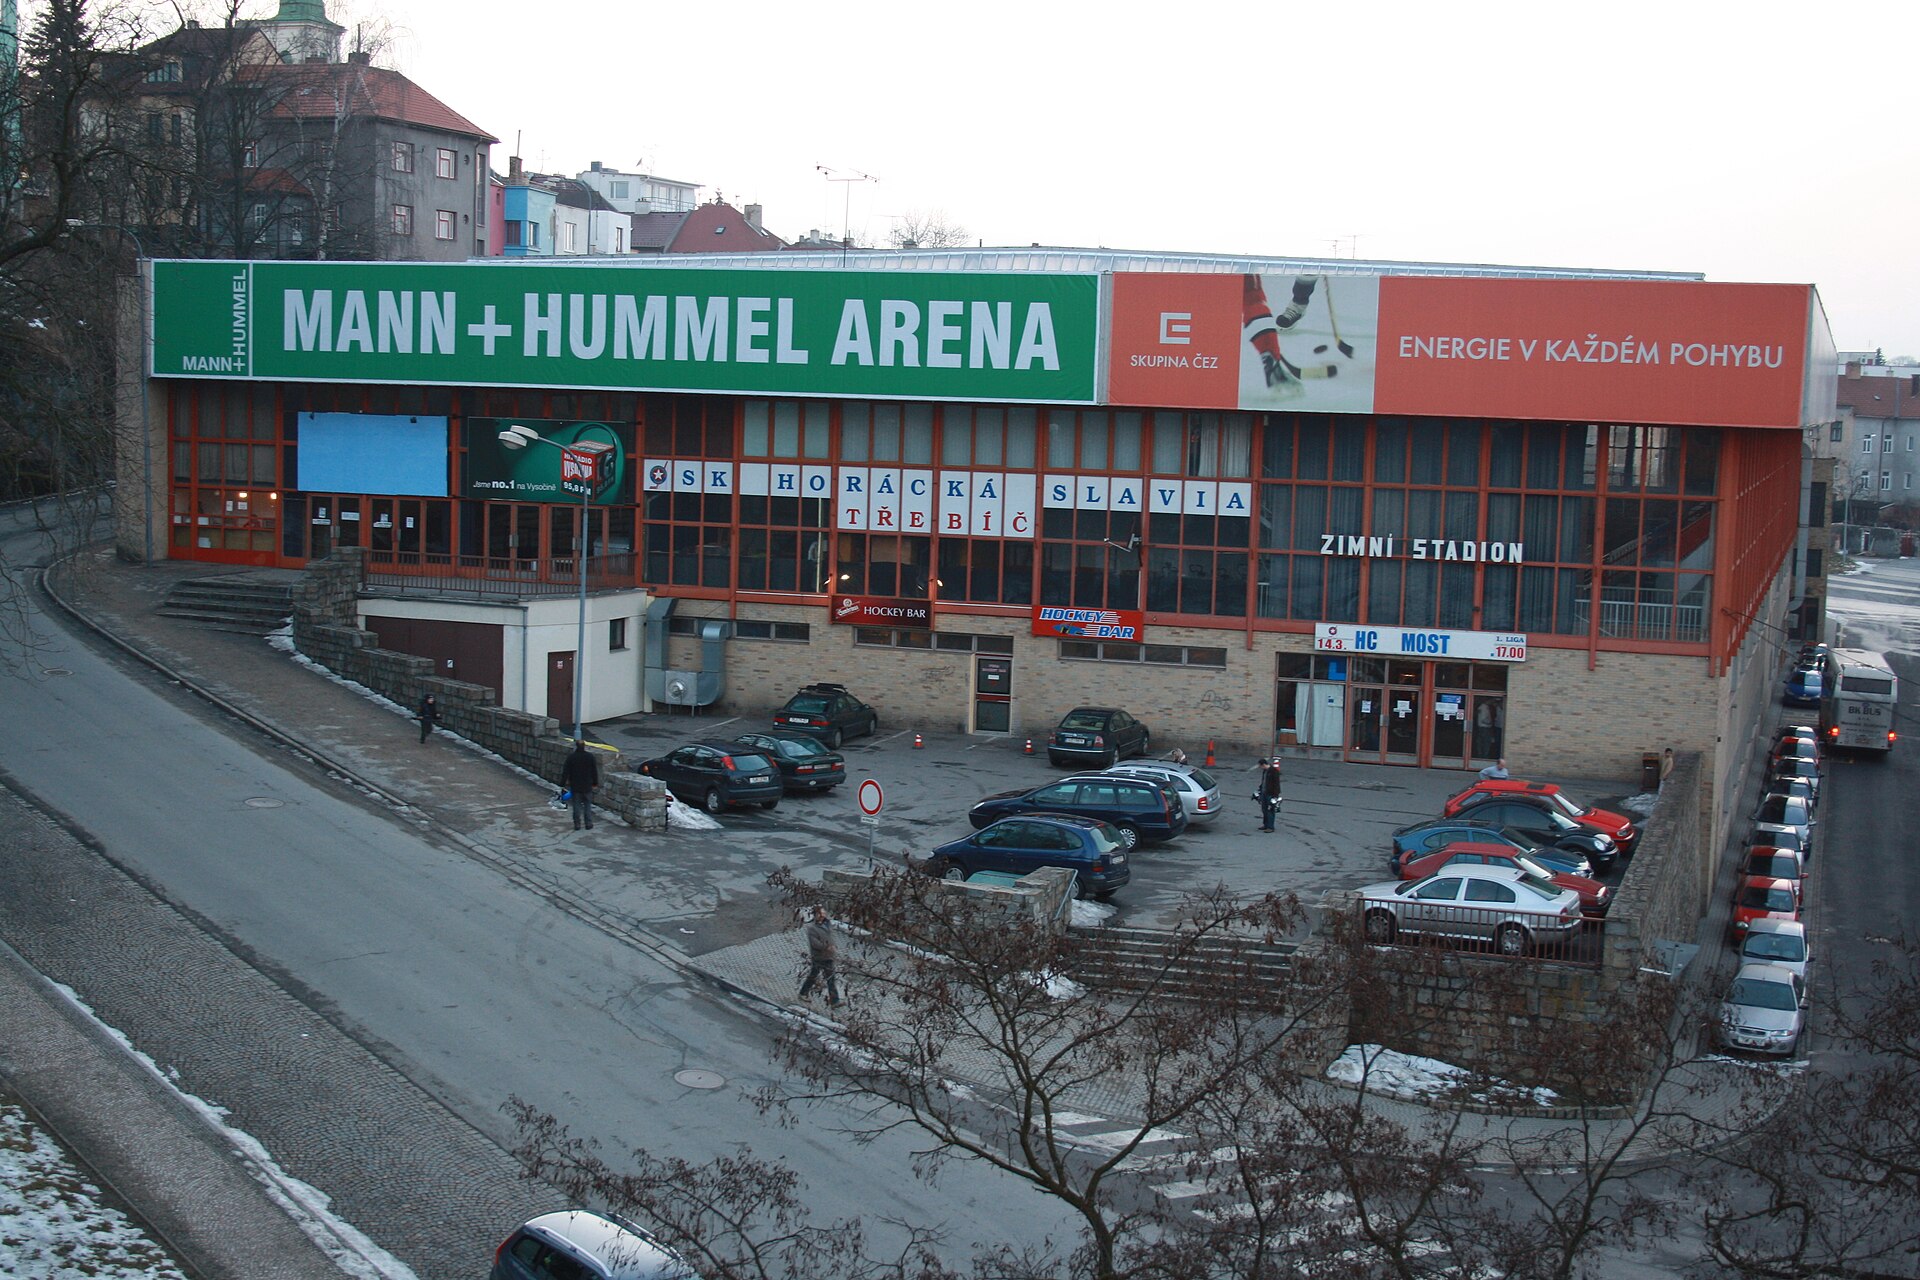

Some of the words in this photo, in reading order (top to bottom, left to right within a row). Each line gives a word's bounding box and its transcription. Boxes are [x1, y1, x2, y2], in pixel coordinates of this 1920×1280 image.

[830, 298, 1061, 371] ARENA
[1399, 335, 1511, 361] ENERGIE
[1519, 339, 1538, 361] V
[1545, 333, 1660, 365] KAŽDÉM
[1670, 343, 1783, 369] POHYBU
[1130, 354, 1189, 368] SKUPINA
[1193, 353, 1218, 369] ČEZ
[492, 479, 515, 489] no.1
[682, 469, 728, 487] SK
[778, 473, 997, 499] HORÁCKÁ
[1052, 484, 1245, 510] SLAVIA
[846, 506, 1028, 533] TŘEBÍČ
[1320, 533, 1393, 558] ZIMNÍ
[1413, 538, 1523, 564] STADION
[864, 606, 904, 617] HOCKEY
[907, 608, 926, 618] BAR
[1039, 607, 1106, 623] HOCKEY
[1096, 625, 1135, 639] BAR
[1317, 639, 1347, 650] 14.3.
[1355, 630, 1378, 650] HC
[1401, 632, 1450, 654] MOST
[1849, 706, 1861, 714] BK
